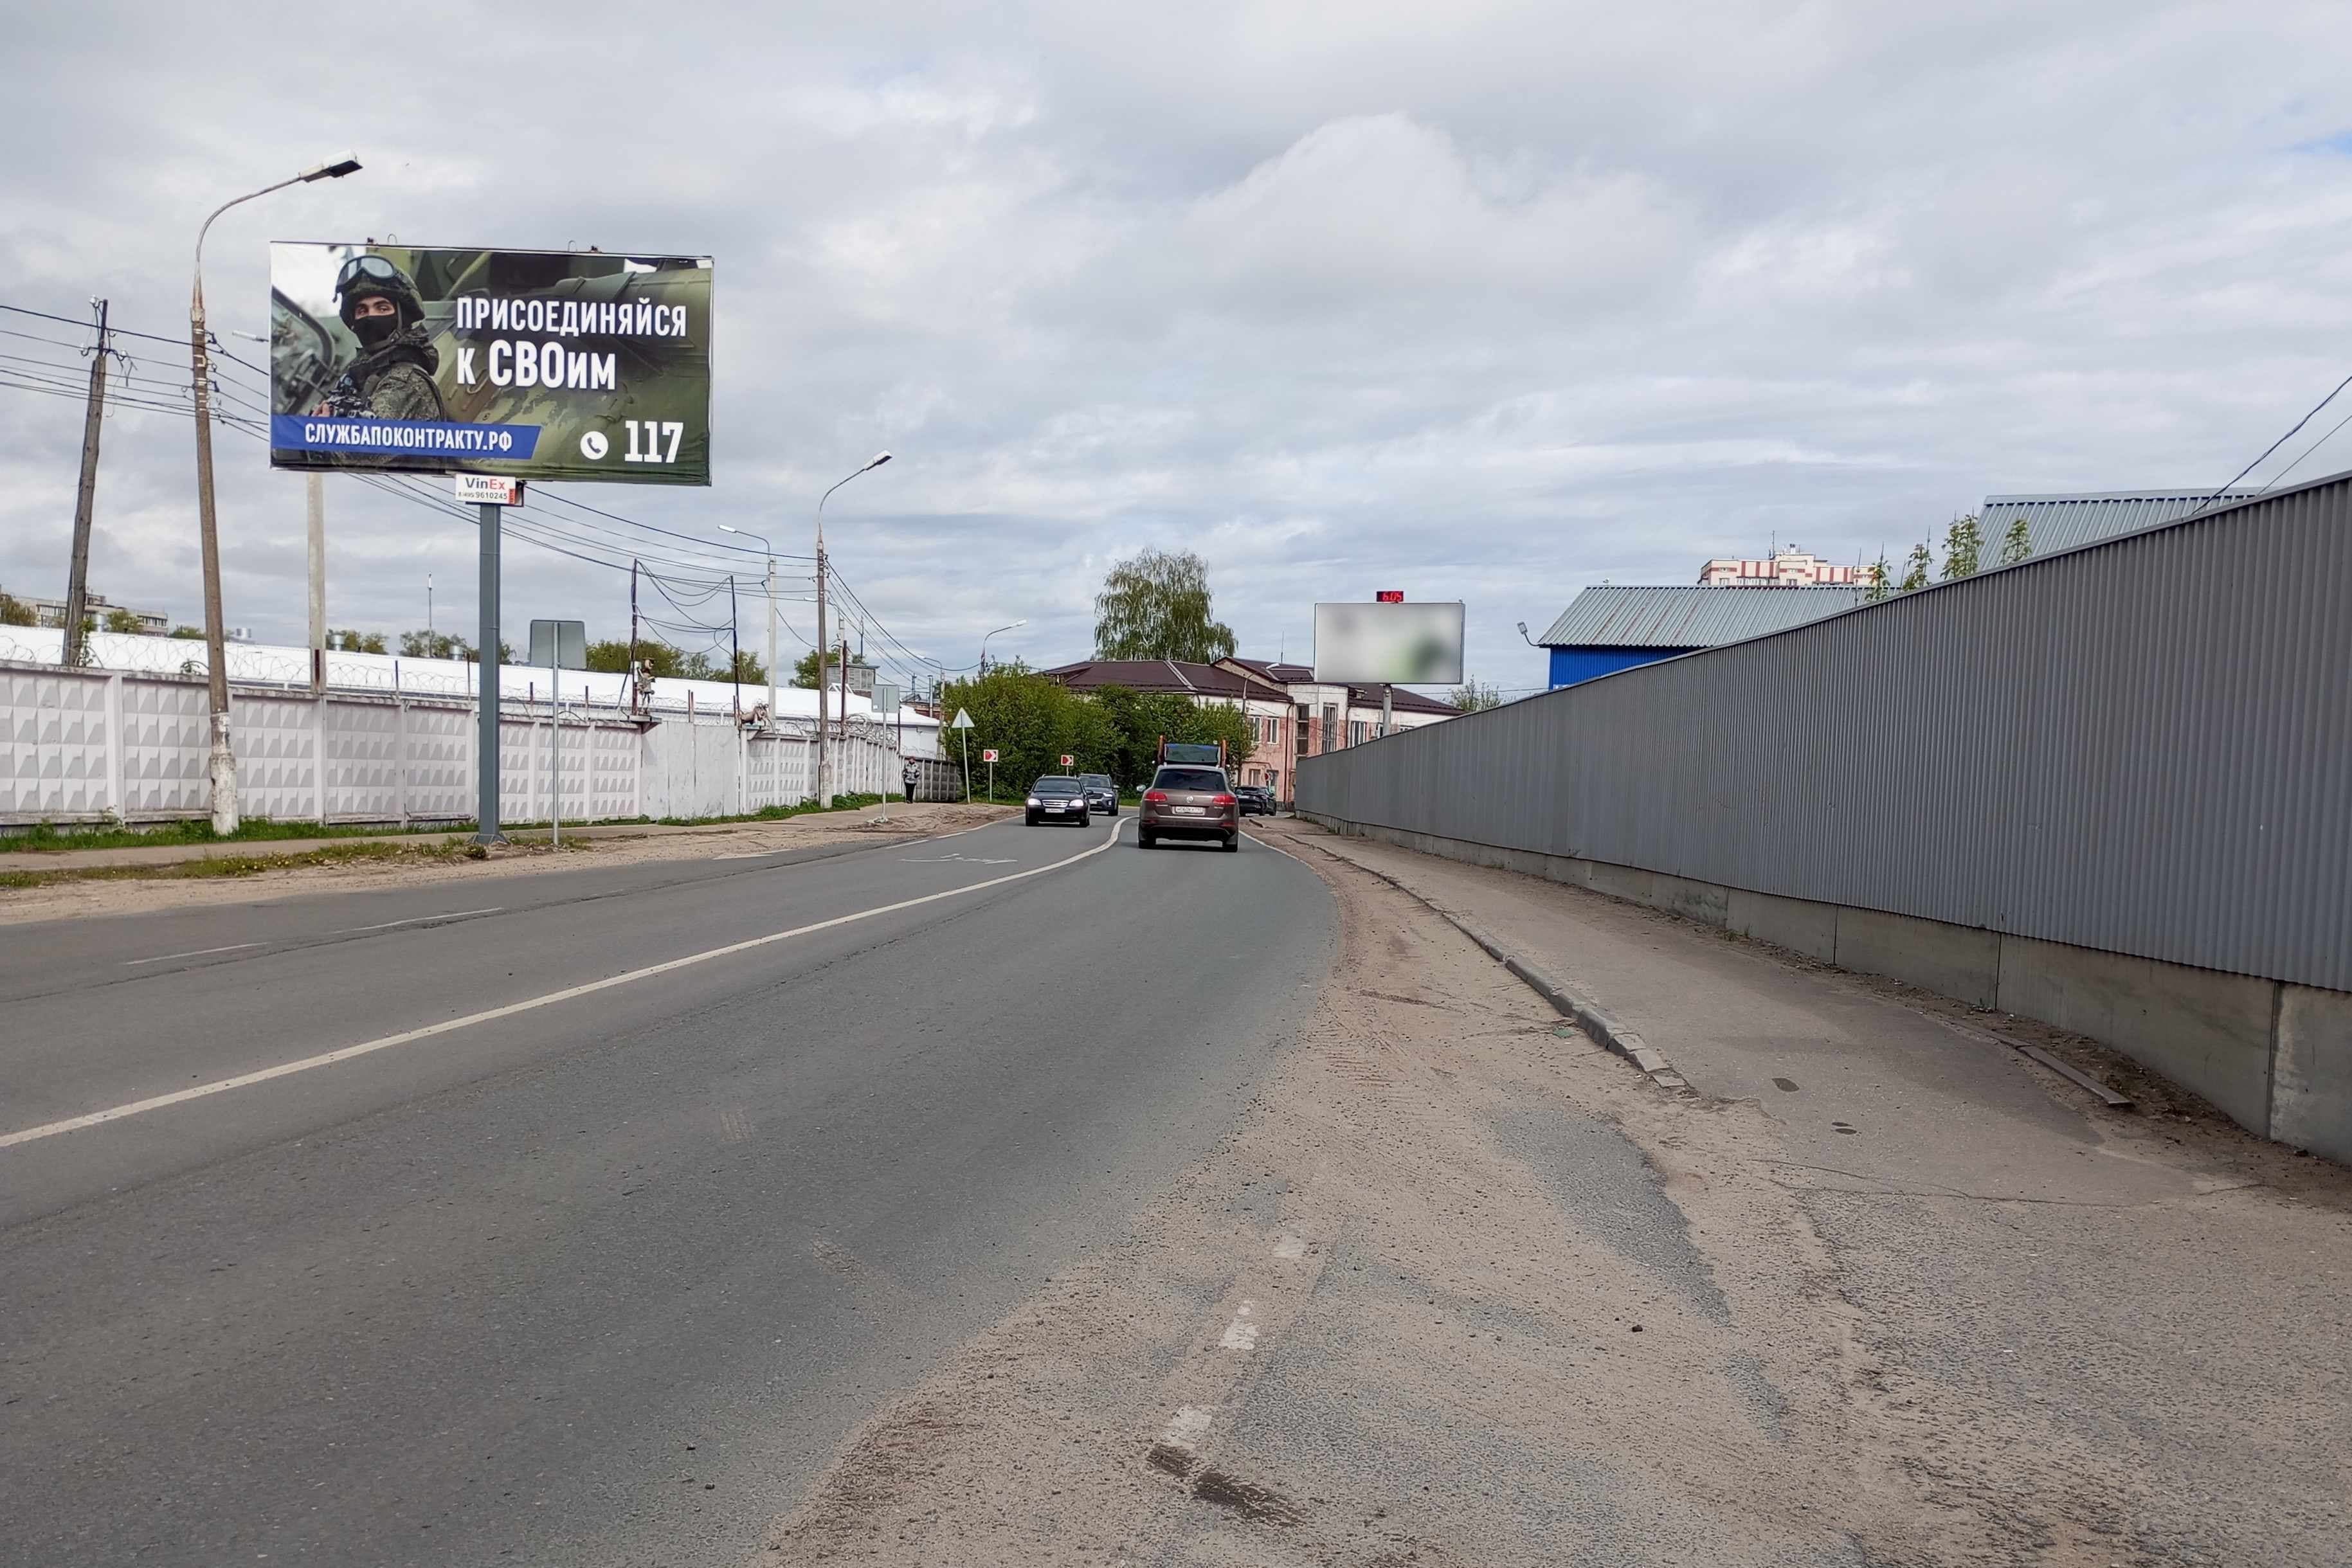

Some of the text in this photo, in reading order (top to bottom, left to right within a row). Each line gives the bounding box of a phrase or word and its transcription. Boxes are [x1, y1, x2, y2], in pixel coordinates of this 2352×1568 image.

[457, 297, 687, 337] ПРИСОЕДИНЯЙСЯ
[305, 423, 512, 451] СЛУЖБАПОКОНТРАКТУ.РФ
[624, 420, 684, 464] 117
[465, 477, 505, 490] VinEx
[475, 491, 508, 500] 9610245
